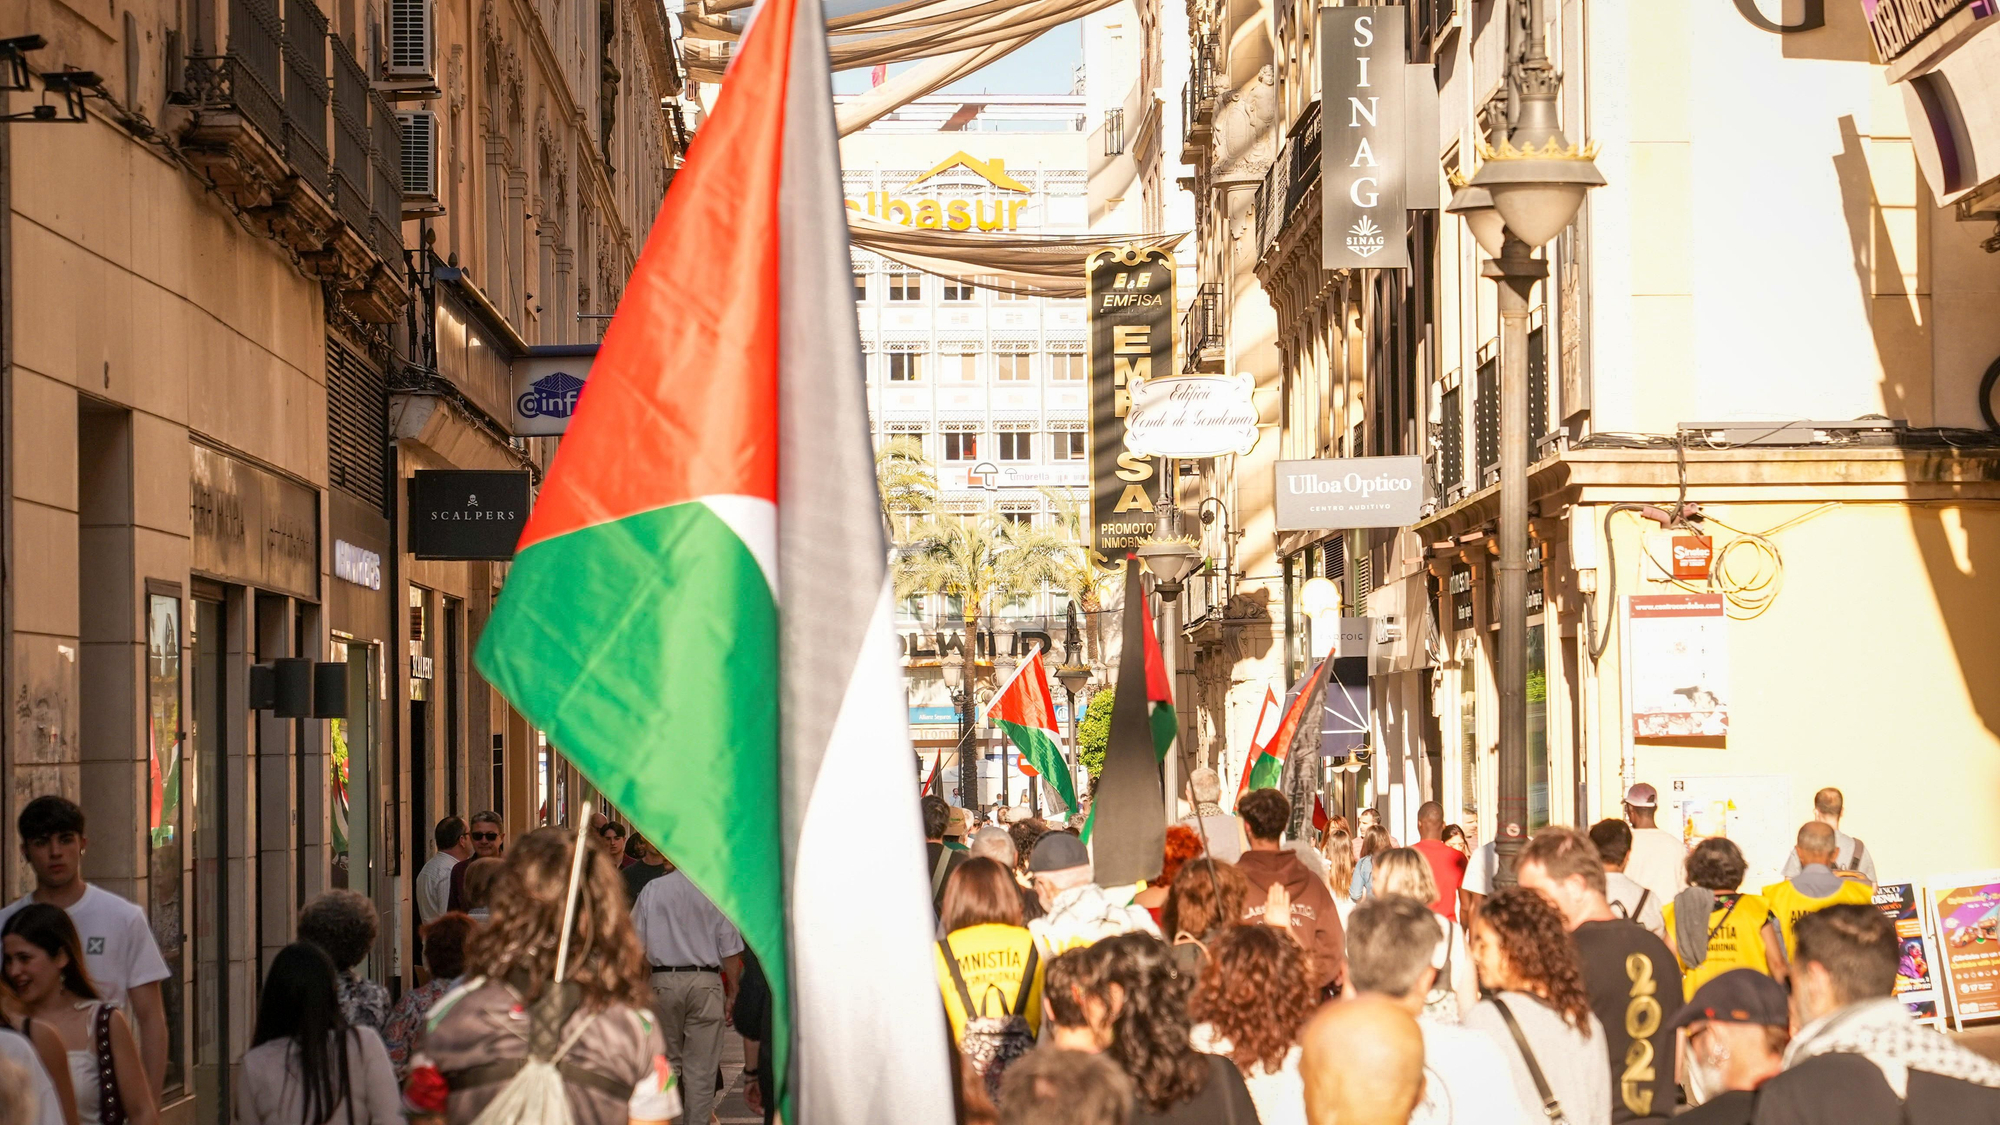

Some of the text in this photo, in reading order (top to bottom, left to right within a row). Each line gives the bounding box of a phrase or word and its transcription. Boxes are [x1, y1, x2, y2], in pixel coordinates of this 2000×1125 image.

[1348, 16, 1380, 208] SINAG
[1346, 236, 1384, 245] SINAG
[1103, 294, 1163, 307] EMFISA
[1113, 326, 1154, 512] EMSA
[1287, 473, 1412, 498] Ulloa Optico
[431, 511, 515, 520] SCALPERS
[1101, 523, 1157, 534] PROMOTO
[957, 947, 1021, 972] MNISTÍA
